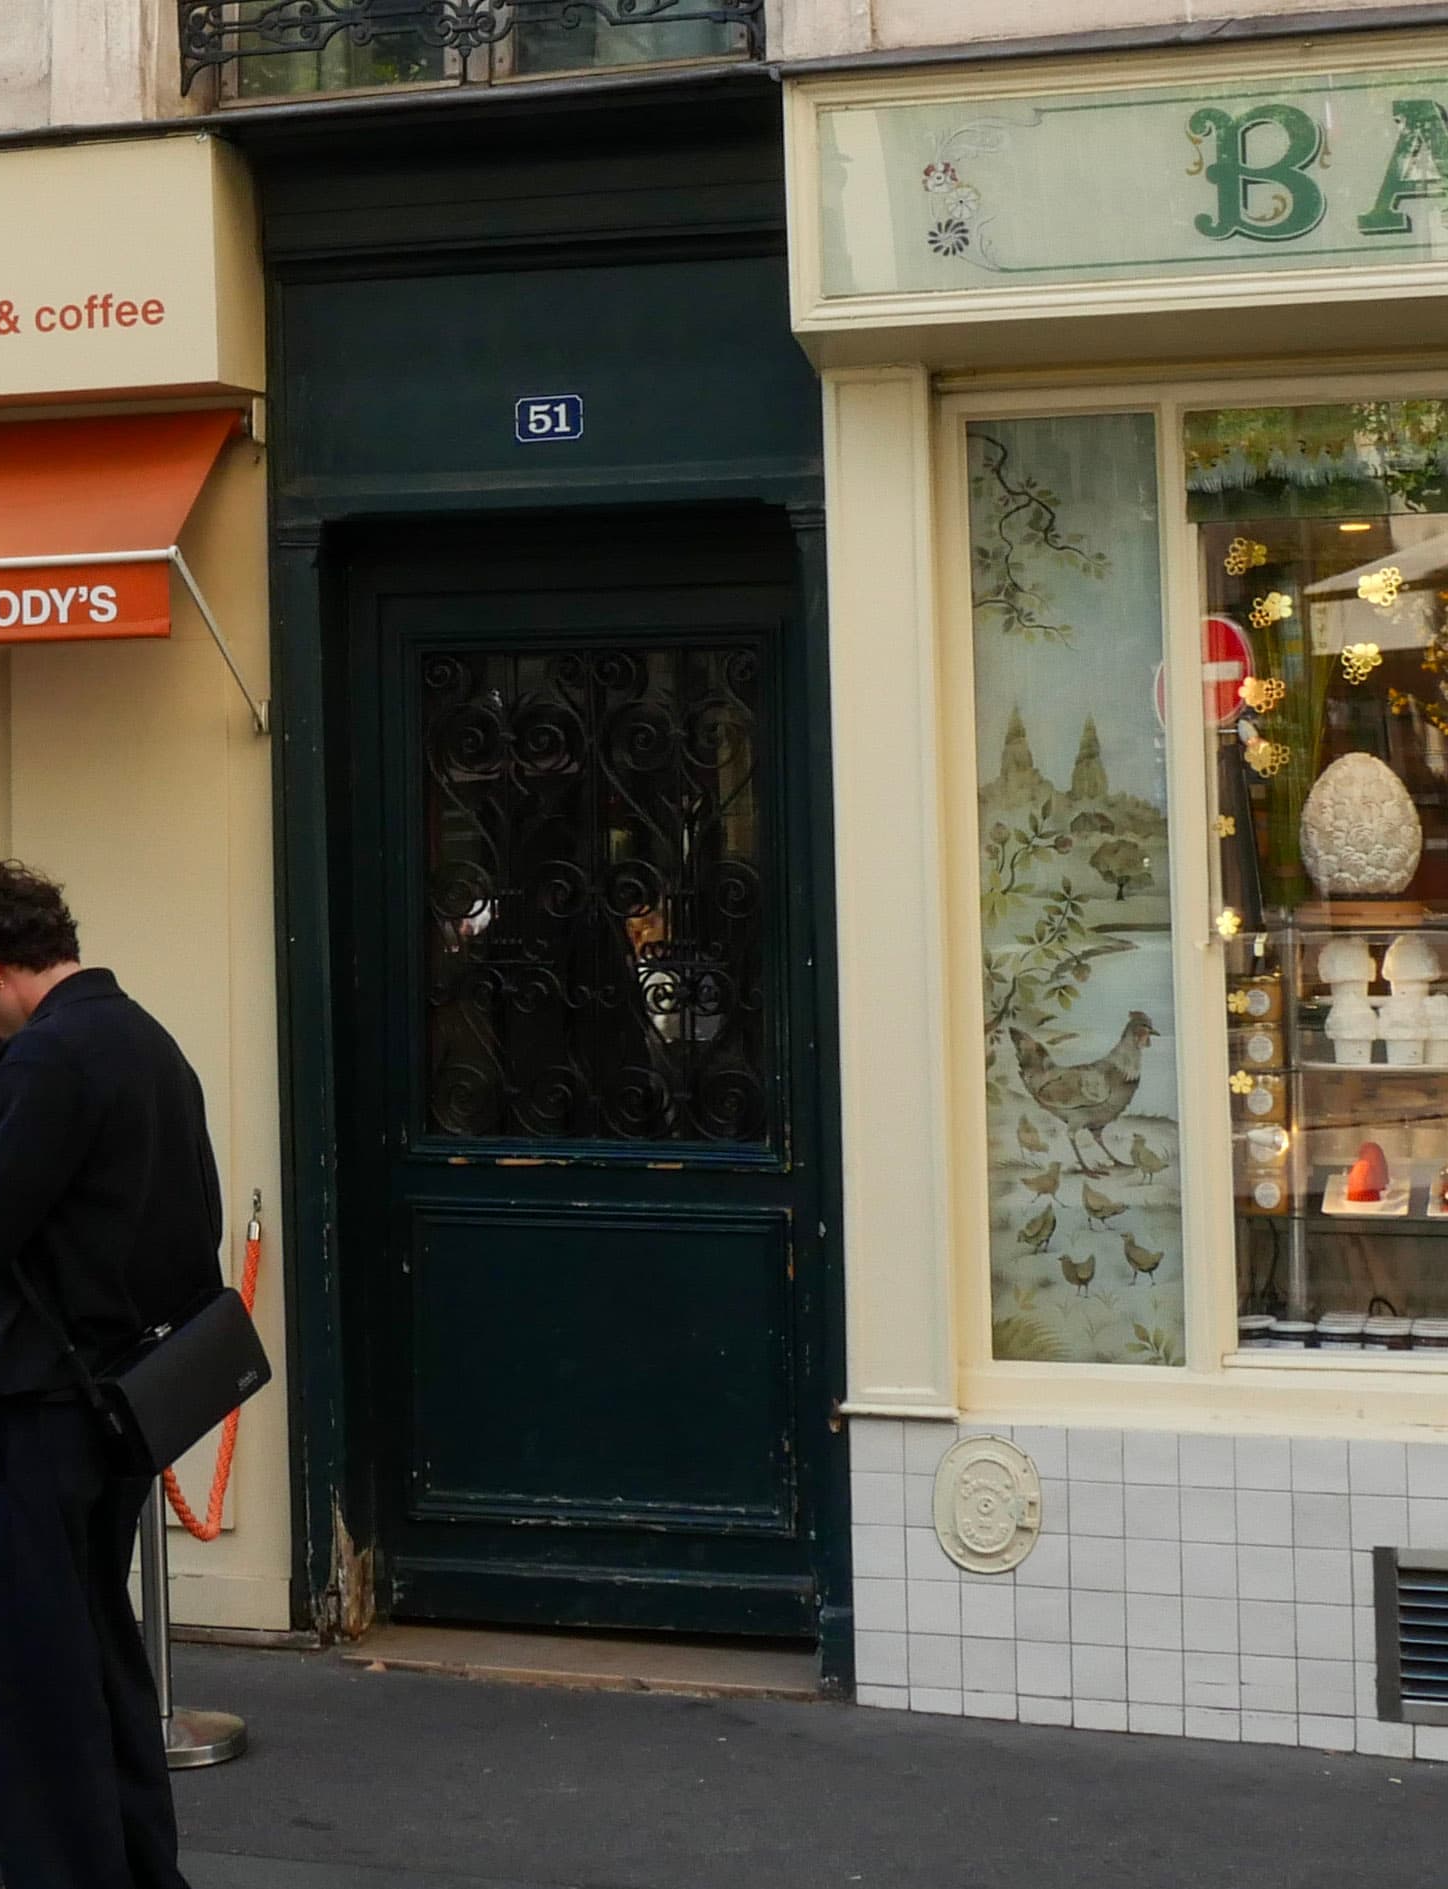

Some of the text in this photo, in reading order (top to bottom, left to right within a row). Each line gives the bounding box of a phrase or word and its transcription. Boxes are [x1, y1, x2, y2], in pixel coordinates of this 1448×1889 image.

[1188, 99, 1448, 242] BA
[35, 293, 165, 333] coffee
[528, 402, 571, 434] 51
